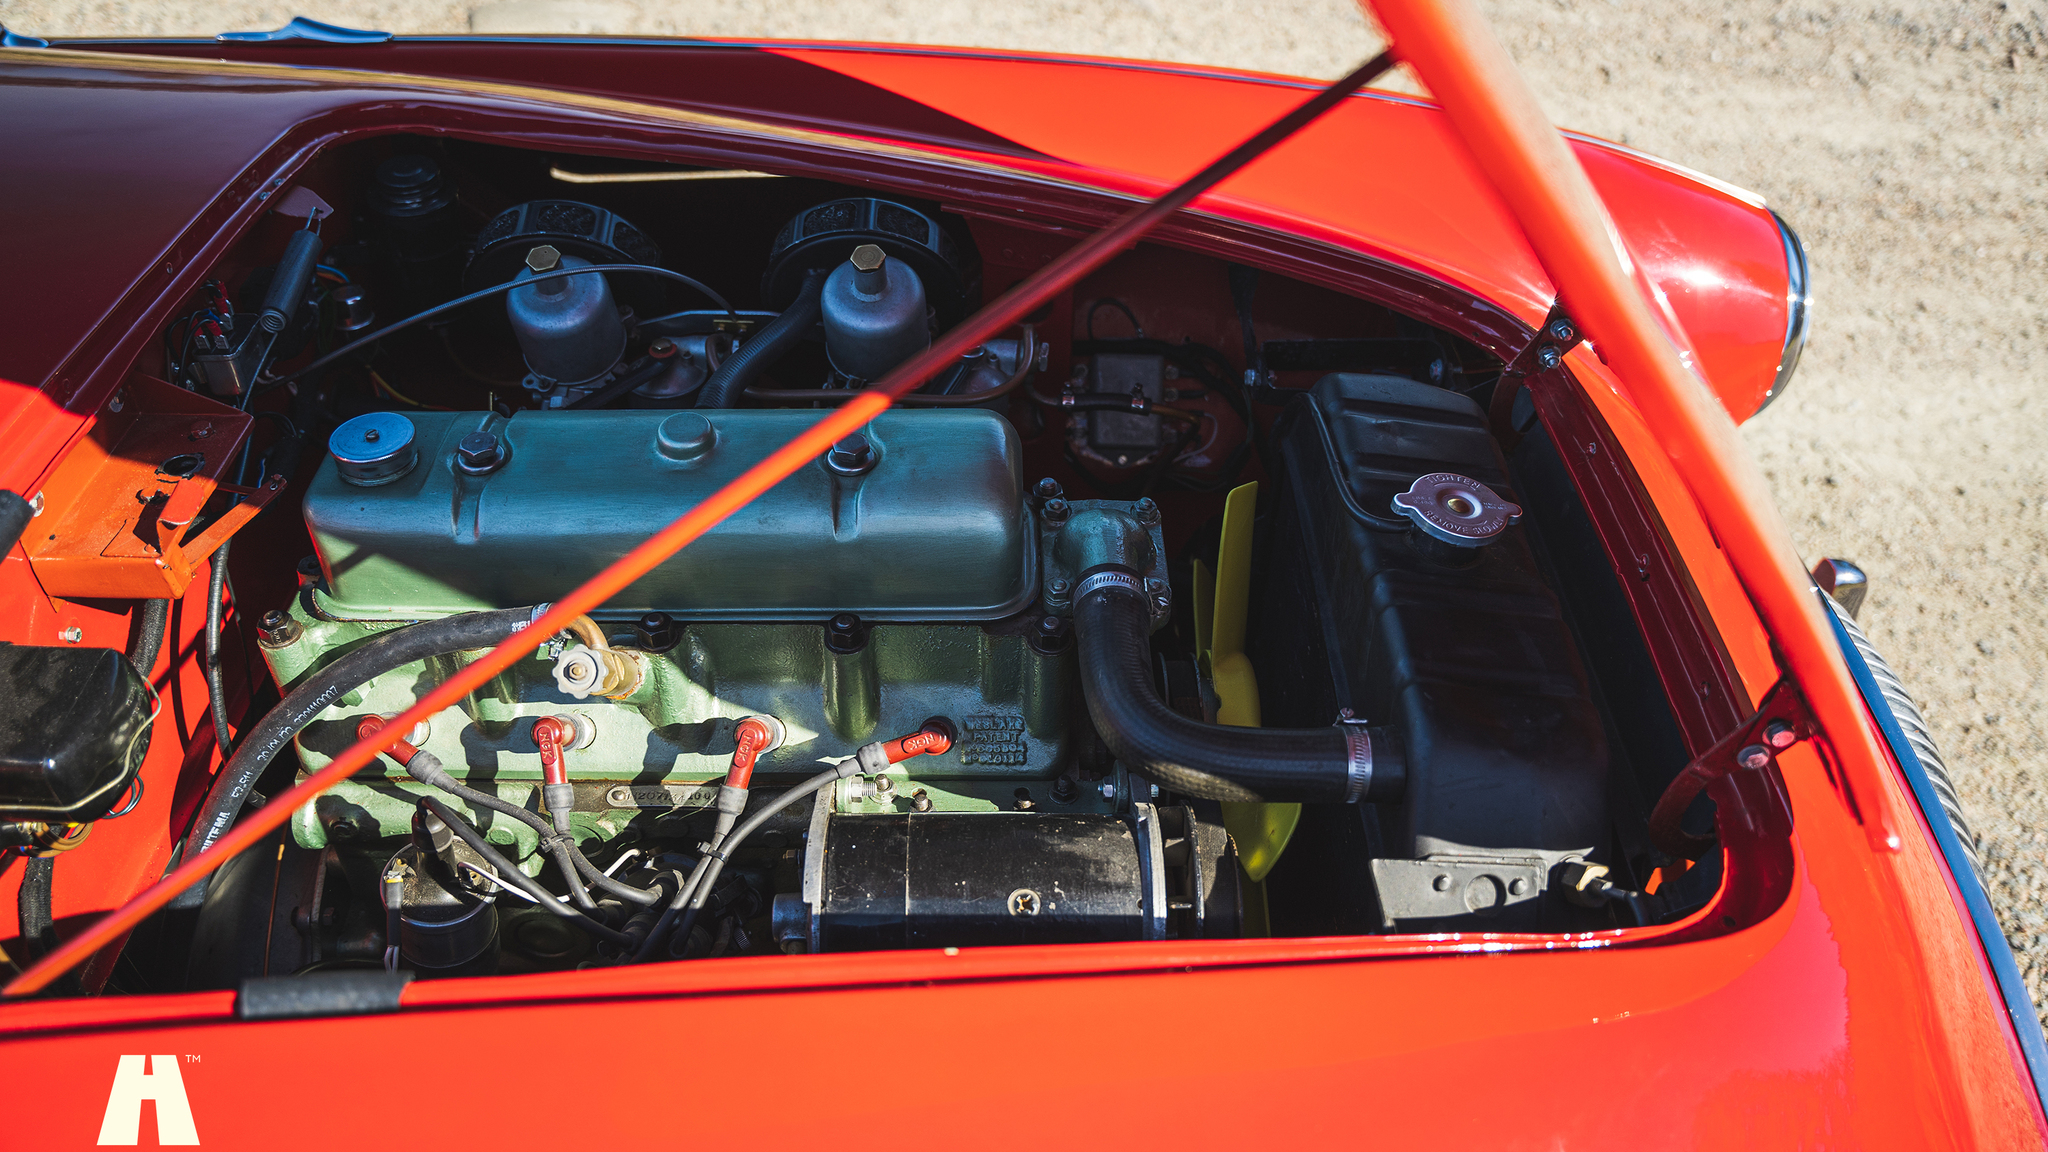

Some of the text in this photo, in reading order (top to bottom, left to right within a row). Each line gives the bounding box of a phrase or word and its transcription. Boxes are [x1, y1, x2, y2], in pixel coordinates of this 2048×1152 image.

[1425, 474, 1481, 491] TIGHTEN
[1424, 510, 1504, 534] REMOVE SLOWLY
[540, 732, 553, 761] NGK
[906, 733, 936, 749] NGK
[973, 732, 1020, 742] PATENT
[739, 734, 755, 763] NGK
